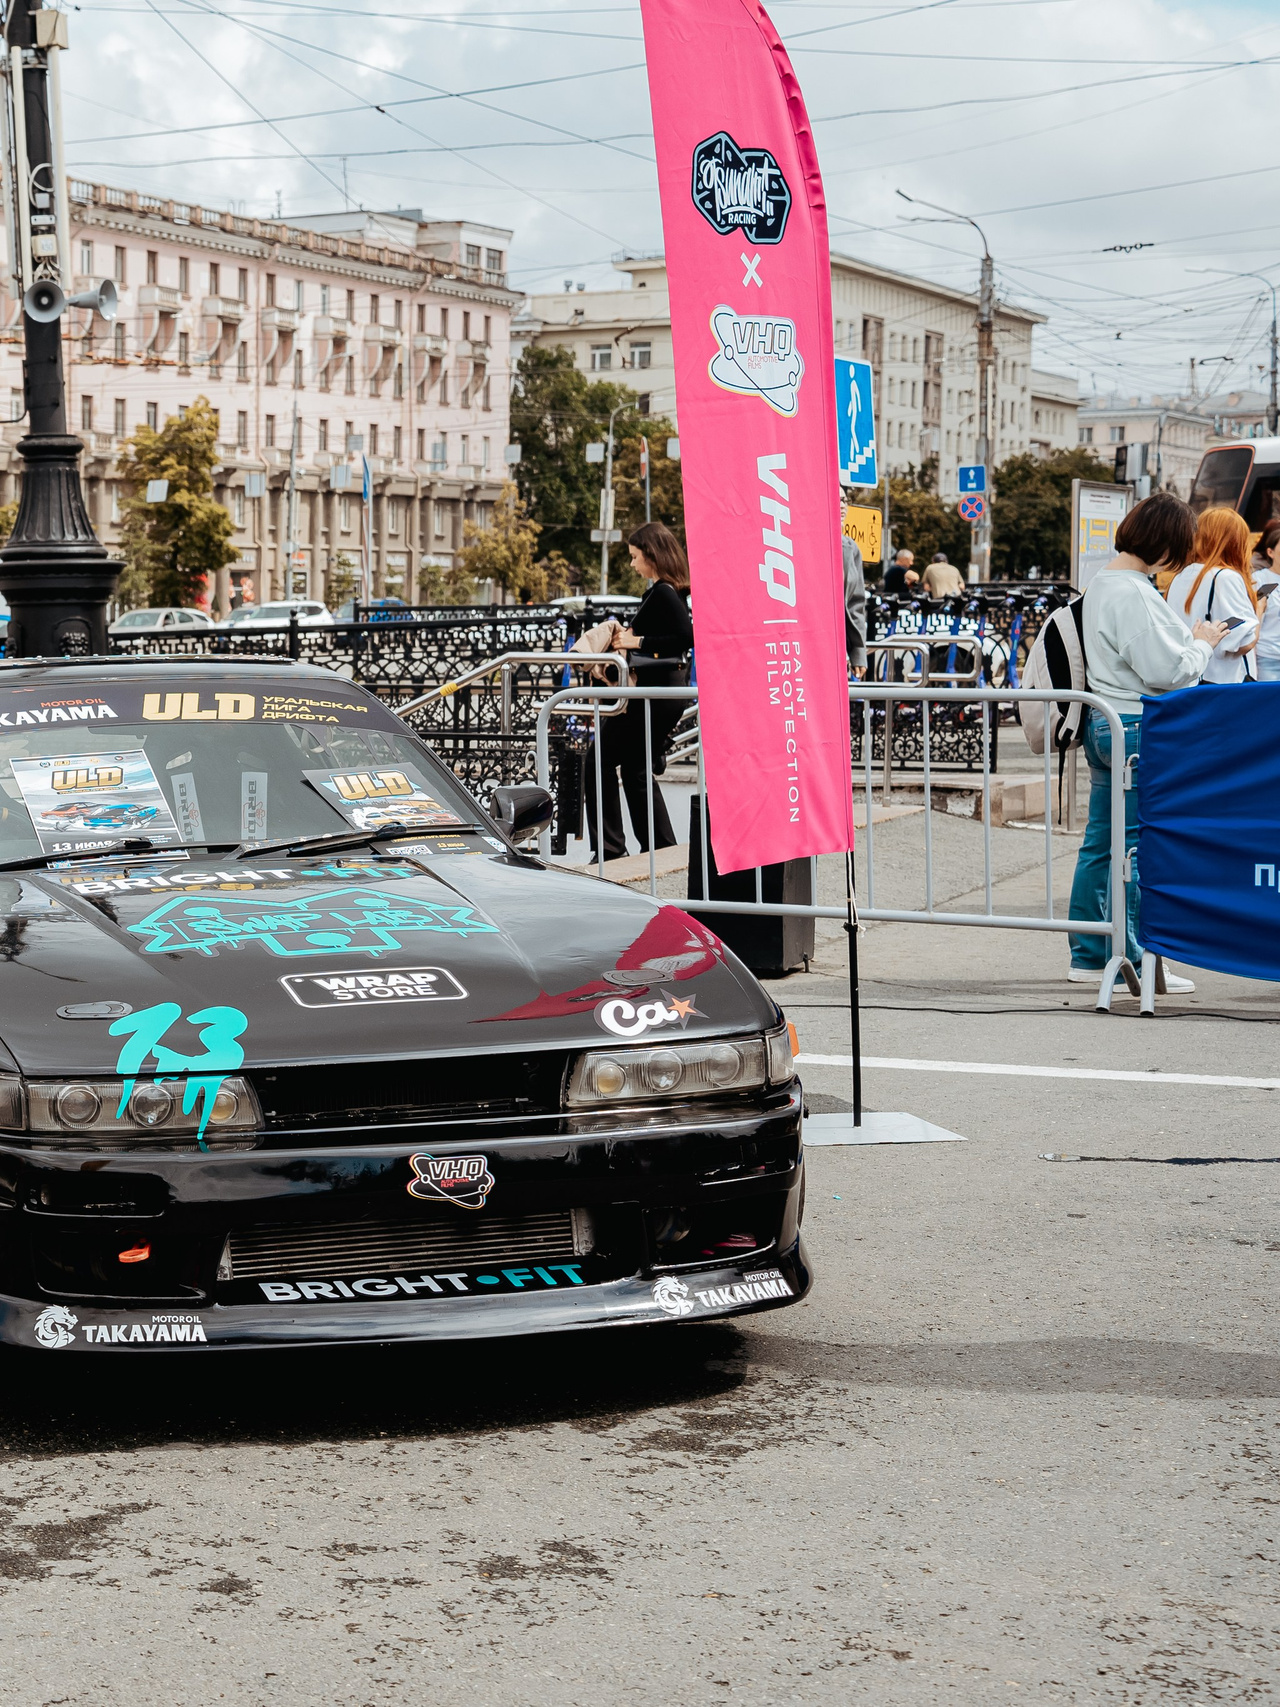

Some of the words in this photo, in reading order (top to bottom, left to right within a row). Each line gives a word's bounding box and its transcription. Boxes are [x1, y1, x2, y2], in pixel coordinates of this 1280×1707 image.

[728, 213, 757, 225] RACING
[732, 322, 792, 361] VHQ
[757, 453, 797, 608] VHQ
[765, 642, 781, 706] FILM
[791, 641, 807, 722] PAINT
[40, 699, 84, 708] MOTOR
[142, 692, 256, 721] ULD
[261, 695, 368, 714] УРАЛЬСКАЯ
[261, 703, 312, 713] ЛИГА
[261, 711, 340, 723] ДРИФТА
[779, 641, 800, 823] PROTECTION
[51, 766, 124, 791] ULD
[331, 772, 415, 800] ULD
[52, 842, 72, 852] 13
[70, 868, 293, 896] BRIGHT
[327, 866, 416, 879] FIT
[312, 972, 439, 989] WRAP
[331, 985, 438, 1001] STORE
[428, 1158, 485, 1181] VHQ
[258, 1271, 470, 1302] BRIGHT
[501, 1263, 586, 1288] FIT
[744, 1272, 770, 1282] MOTOR
[694, 1278, 794, 1308] TAKAYAMA
[81, 1323, 208, 1343] TAKAYAMA
